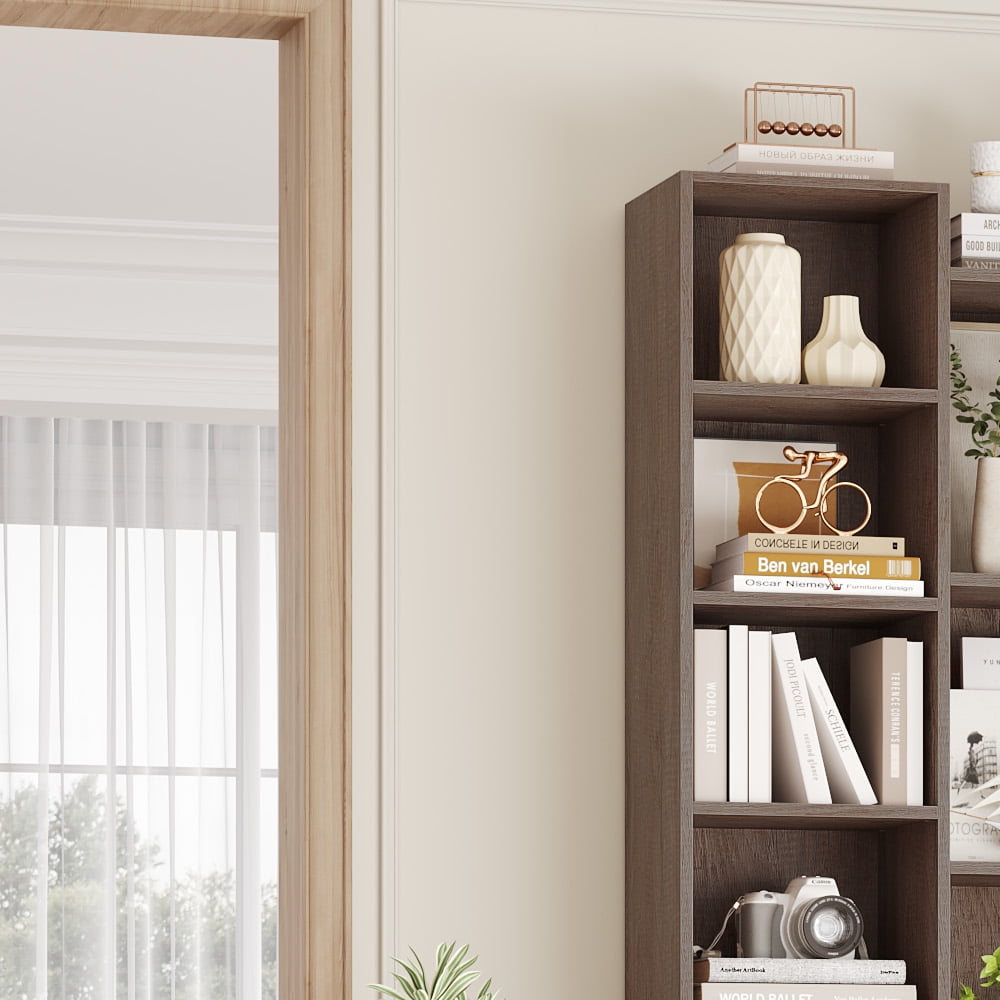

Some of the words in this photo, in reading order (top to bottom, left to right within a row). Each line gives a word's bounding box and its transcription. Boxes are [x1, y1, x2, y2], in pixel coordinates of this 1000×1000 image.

[800, 152, 833, 161] ОБРАЗ
[837, 153, 875, 163] ЖИЗНИ
[965, 240, 986, 252] GOOD
[757, 556, 788, 573] Ben
[791, 561, 819, 574] van
[823, 559, 870, 576] Berkel
[745, 578, 782, 587] Oscar
[846, 583, 883, 591] Furniture
[885, 584, 915, 593] Design
[783, 659, 798, 681] JODI
[705, 682, 717, 718] WORLD
[789, 681, 806, 719] PICOULT
[890, 672, 901, 706] TERENCE
[705, 719, 717, 753] BALLET
[824, 708, 851, 753] SCHIELE
[890, 707, 901, 743] CONRAN'S
